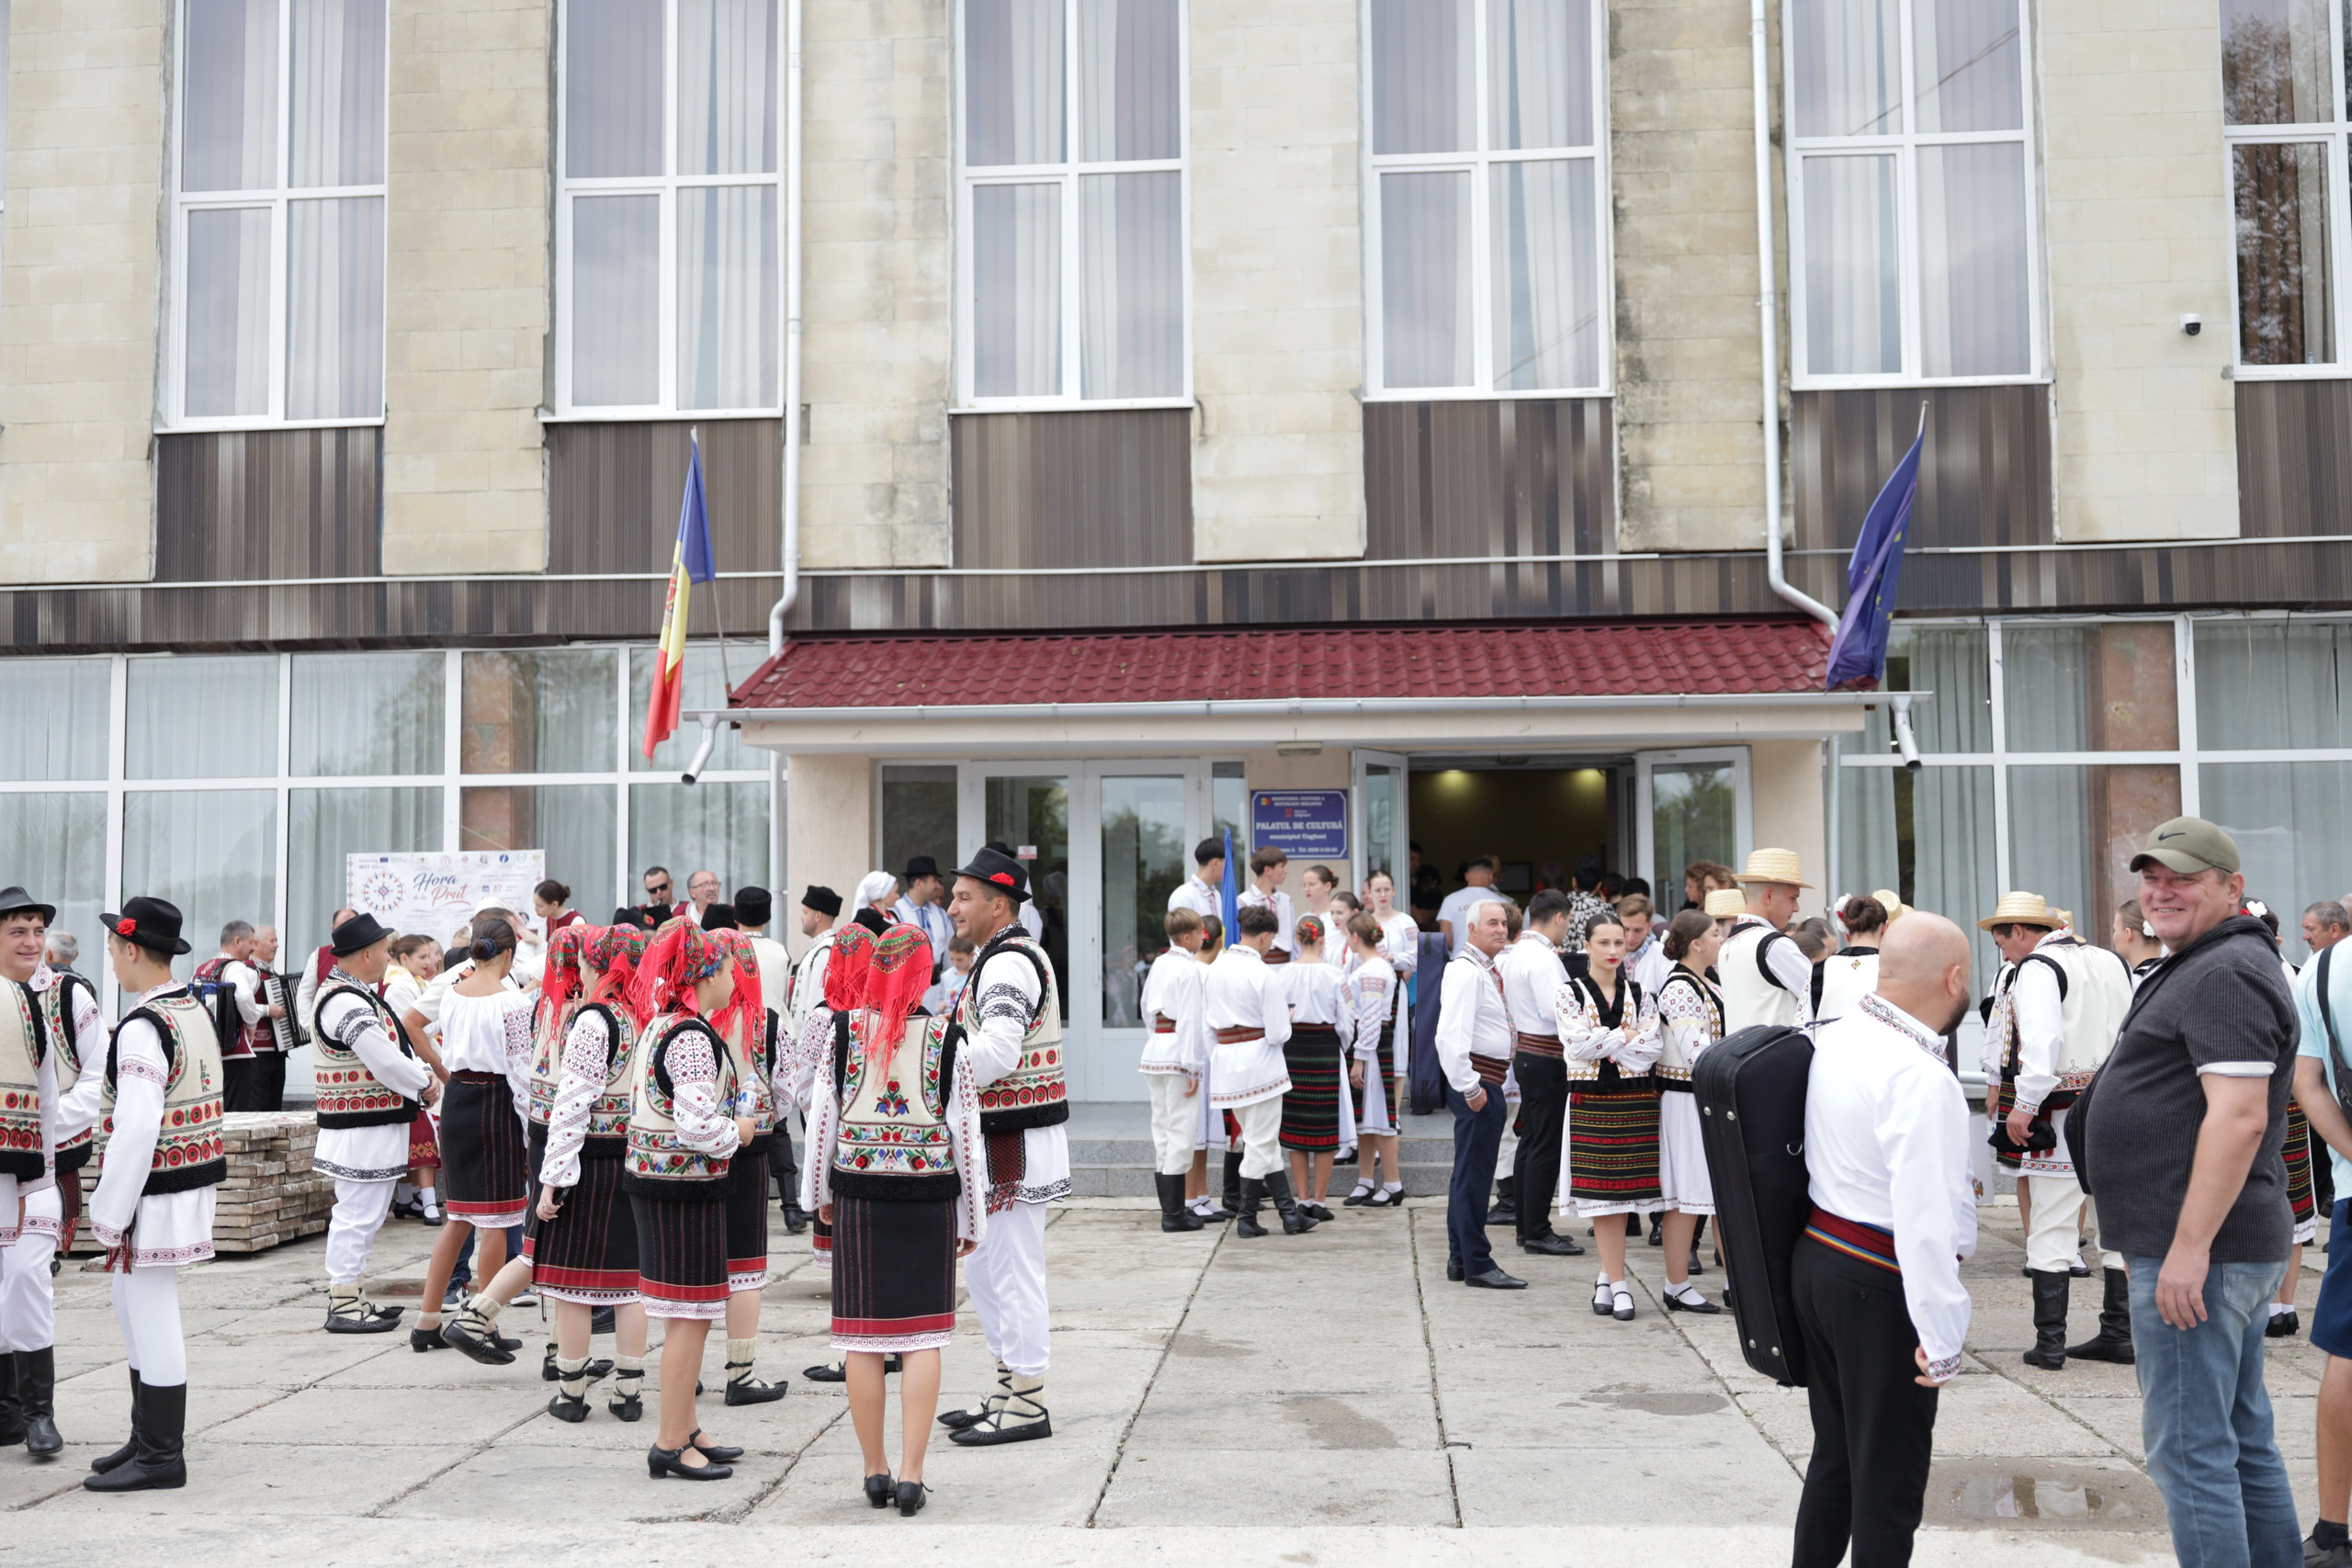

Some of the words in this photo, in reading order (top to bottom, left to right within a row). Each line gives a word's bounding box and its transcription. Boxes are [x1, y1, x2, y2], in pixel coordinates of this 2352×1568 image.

[1293, 821, 1305, 829] DE
[1306, 820, 1343, 829] CULTURĂ
[413, 872, 456, 892] Hora
[431, 883, 470, 907] Prut
